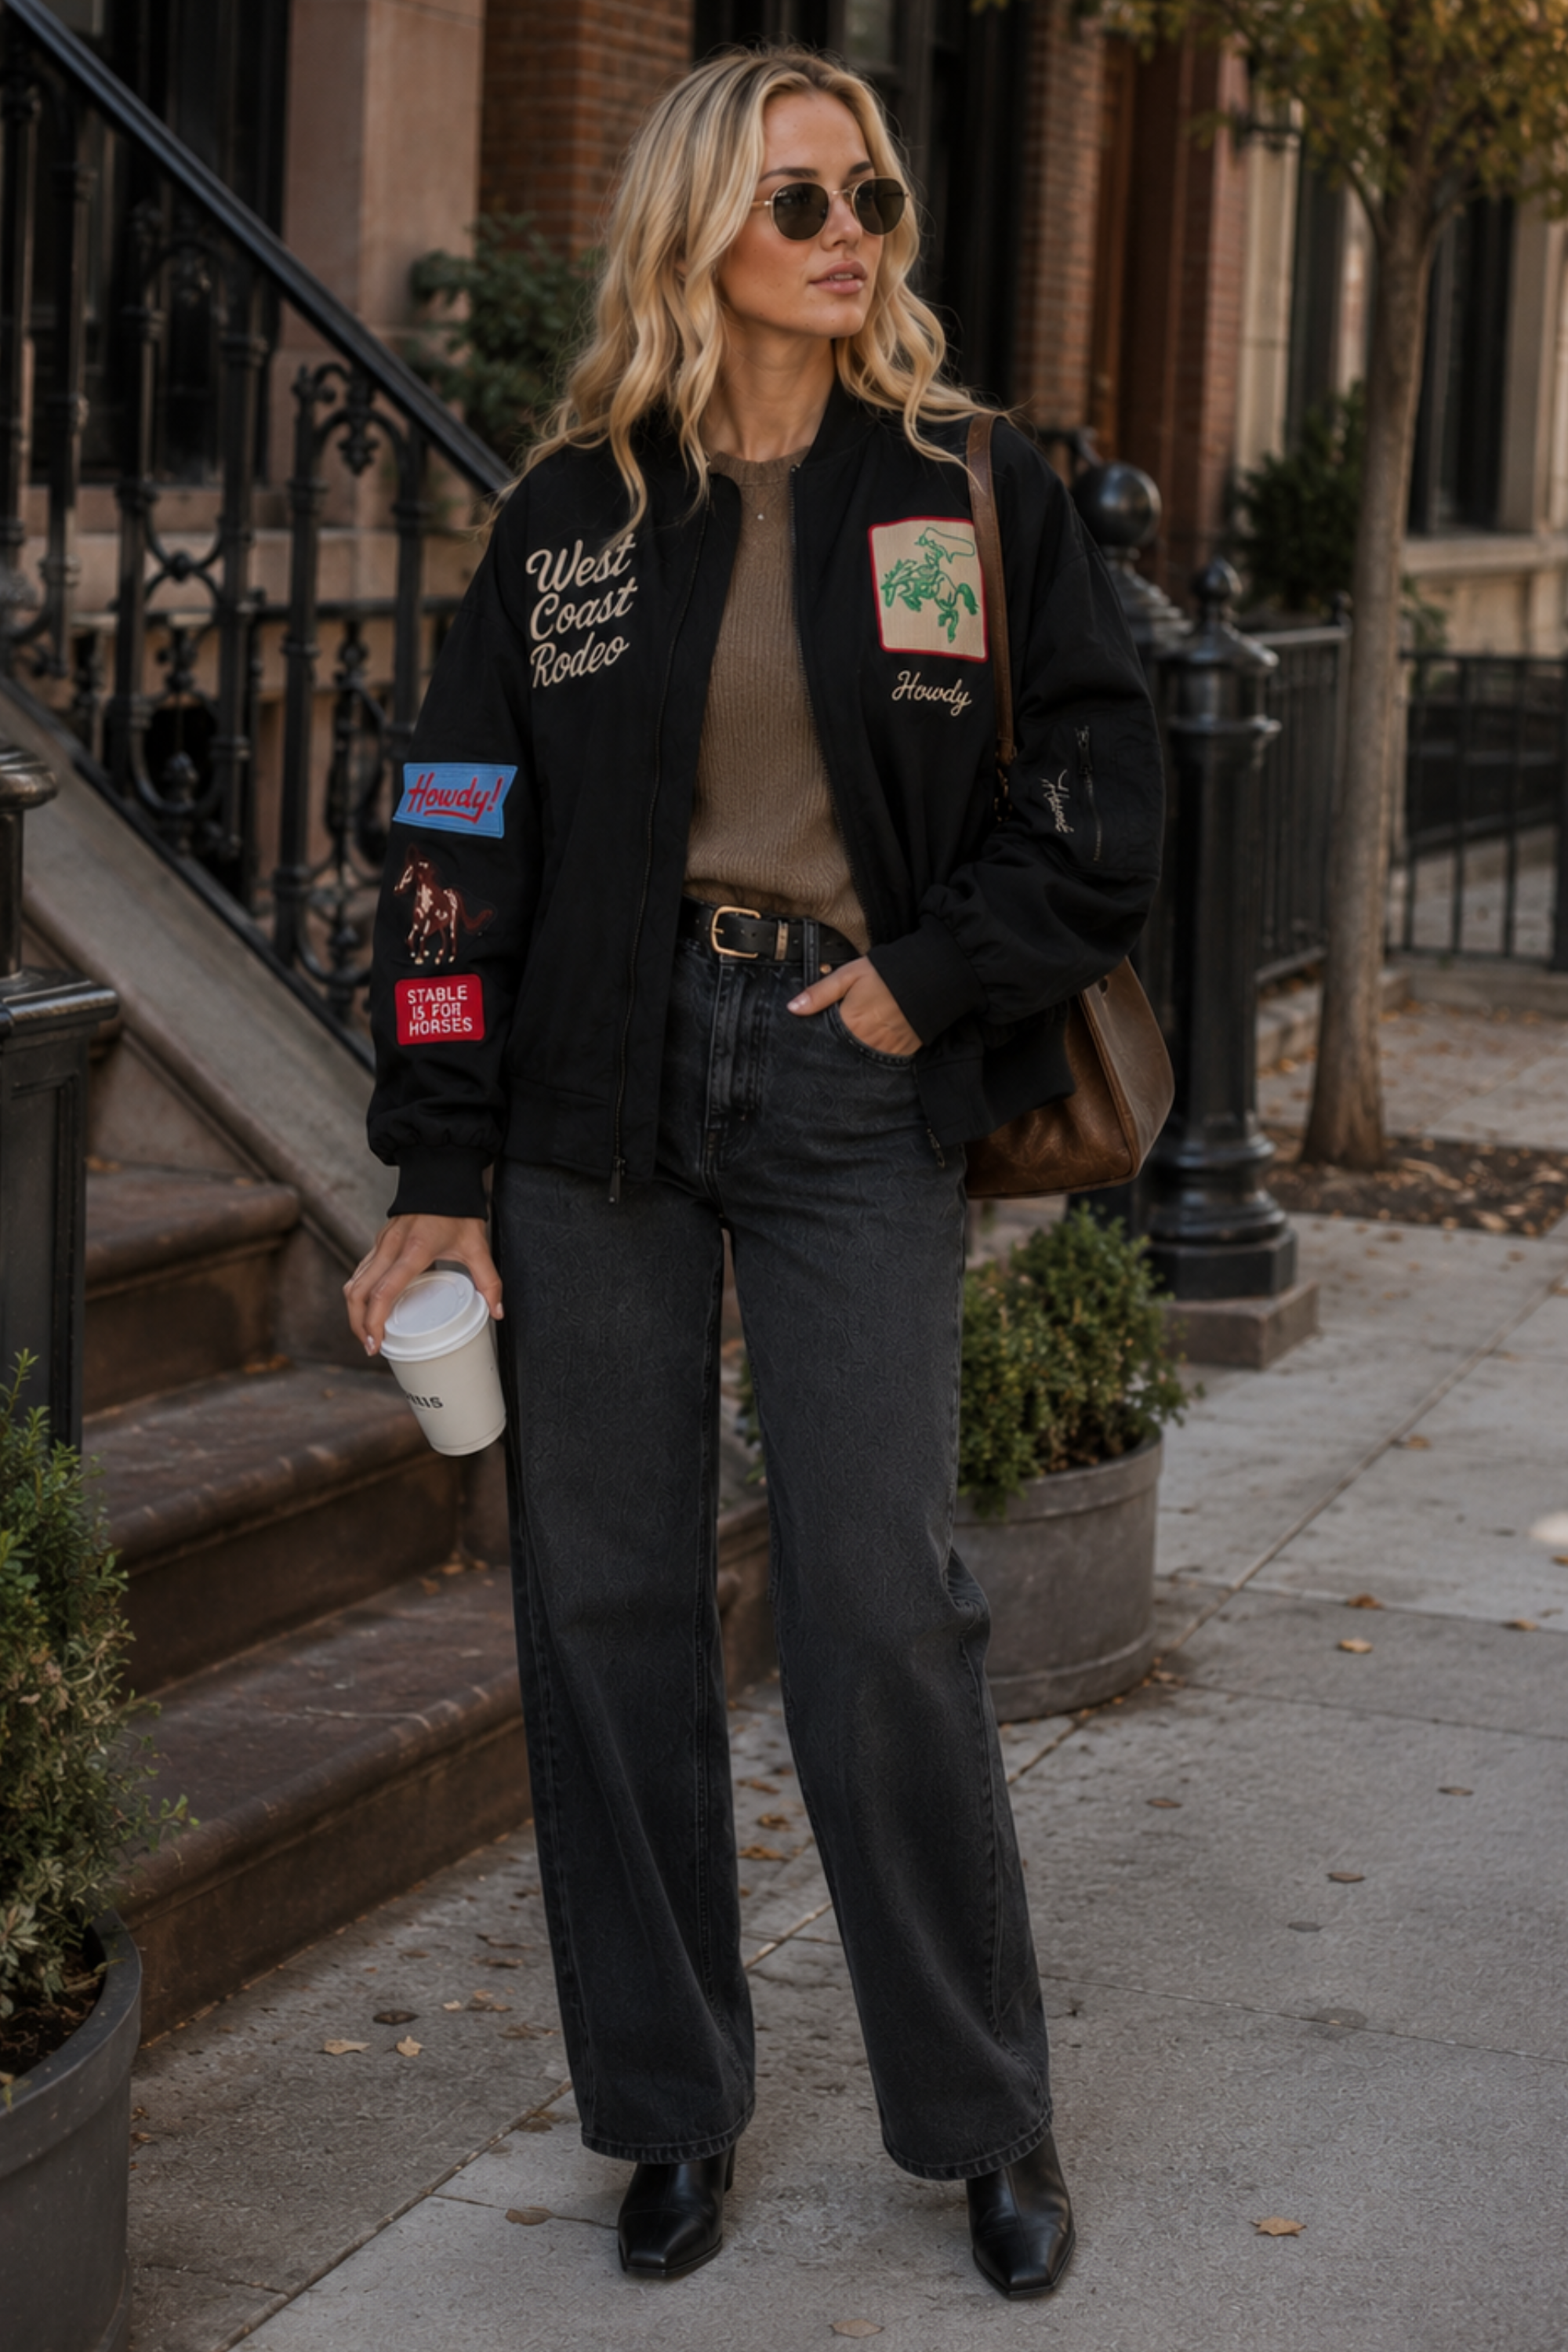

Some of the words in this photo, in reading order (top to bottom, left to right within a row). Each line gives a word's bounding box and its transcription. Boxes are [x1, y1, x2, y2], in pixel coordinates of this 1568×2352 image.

[525, 533, 636, 592] West
[530, 577, 637, 641] Coast
[530, 631, 630, 688] Rodeo
[891, 670, 972, 717] Howdy
[407, 771, 504, 823] Howdy!
[407, 985, 468, 1004] STABLE
[412, 1005, 426, 1020] IS
[431, 1002, 462, 1018] FOR
[408, 1017, 474, 1037] HORSES
